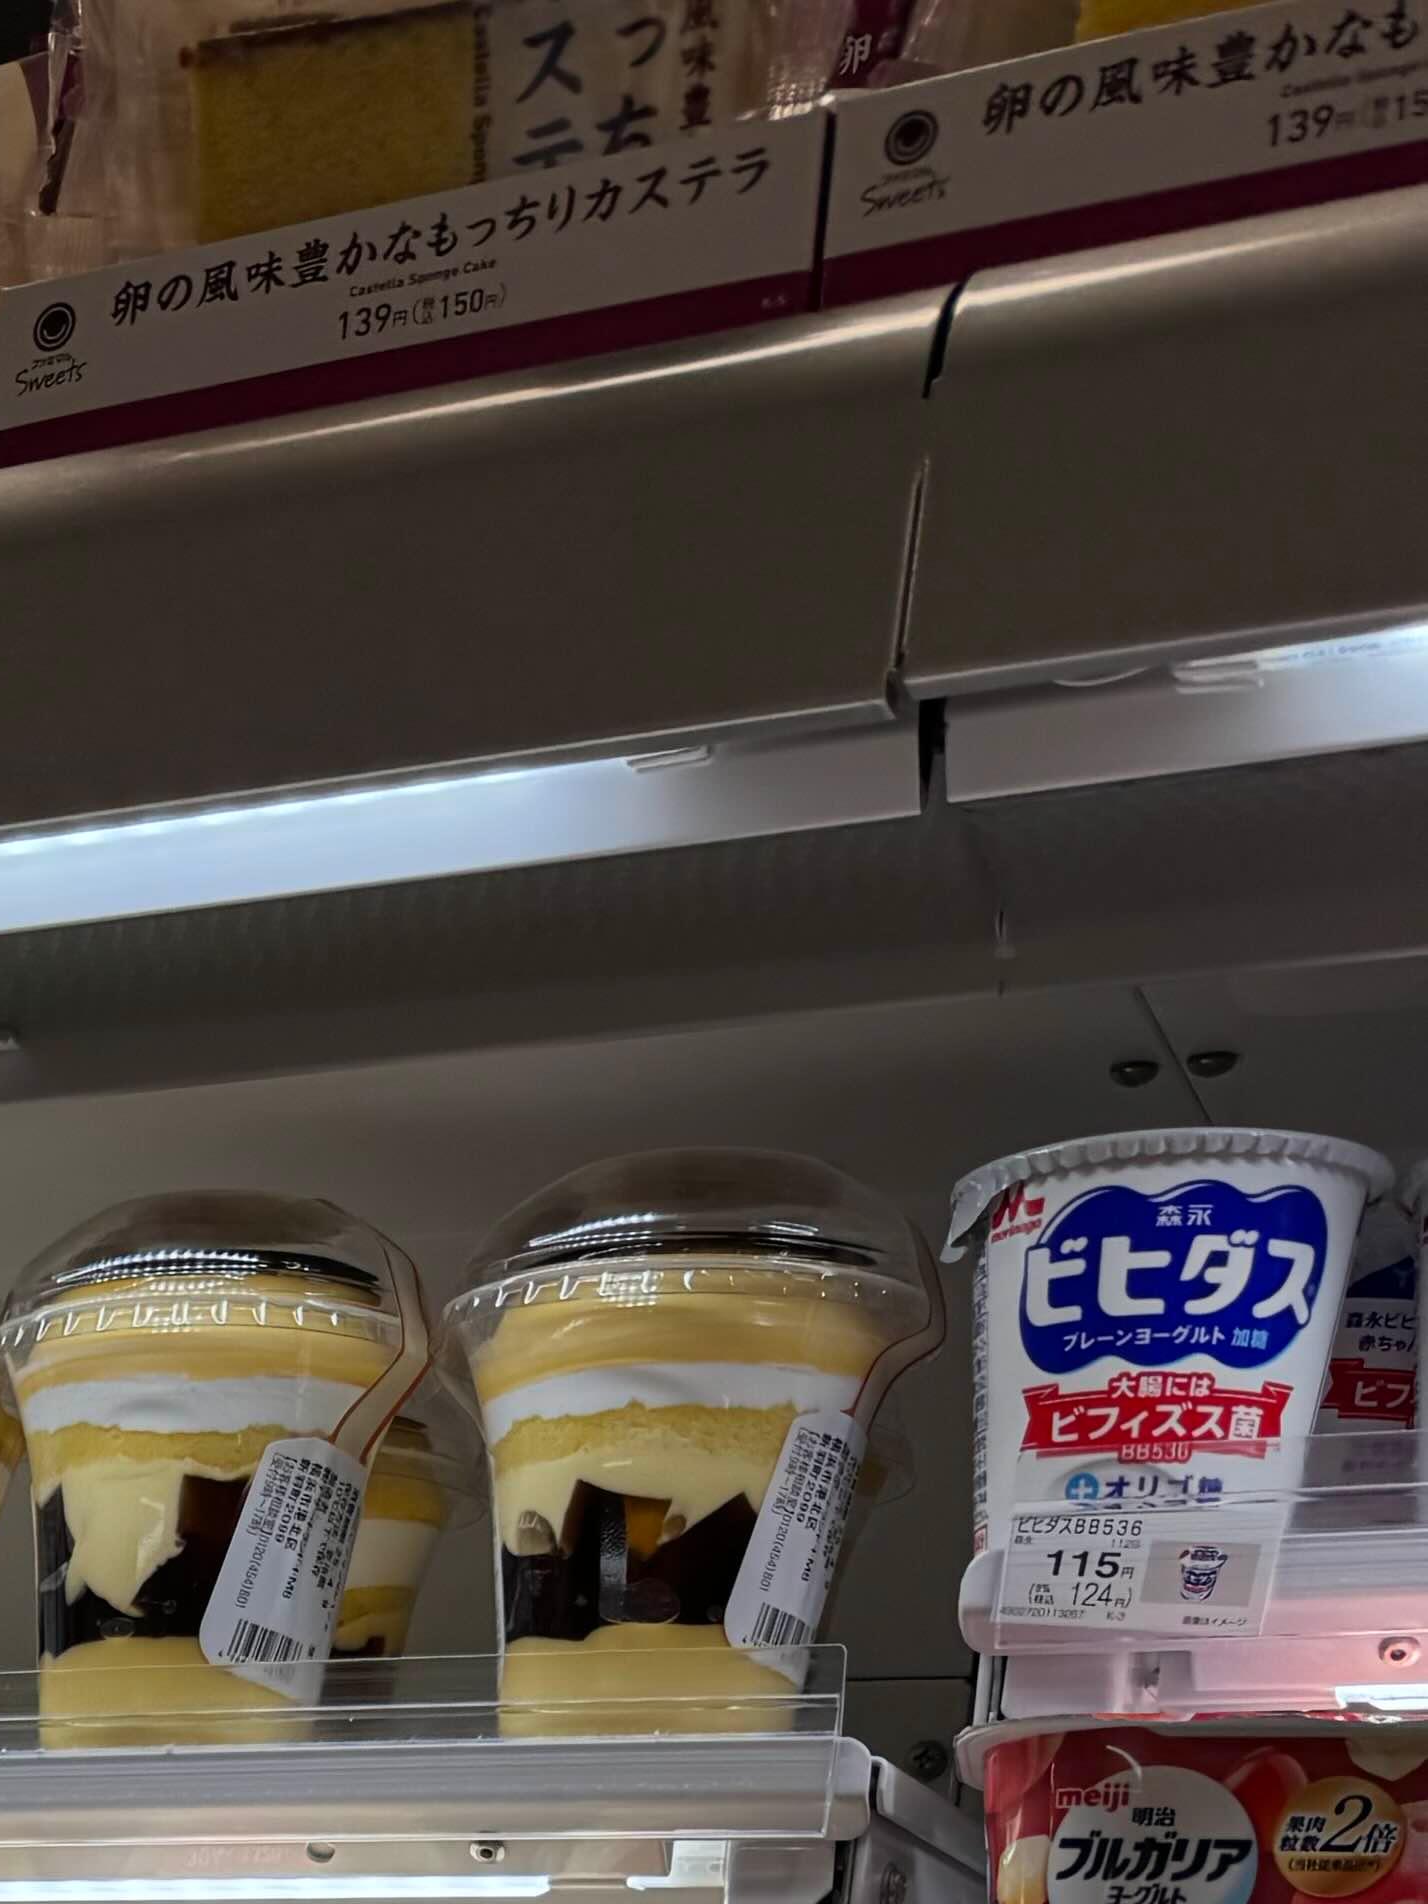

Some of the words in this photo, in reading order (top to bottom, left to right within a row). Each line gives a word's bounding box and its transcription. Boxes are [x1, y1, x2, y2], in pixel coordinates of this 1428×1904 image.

[838, 32, 873, 76] 卵
[859, 176, 950, 217] Sweets
[110, 145, 773, 330] 卵の風味豊かなもっちりカステラ
[467, 257, 498, 275] Cake
[16, 360, 88, 397] Sweets
[1154, 1203, 1214, 1228] 森永
[1026, 1232, 1318, 1328] ビヒダス
[1062, 1326, 1226, 1354] プレーンヨーグルト
[1232, 1326, 1268, 1350] 加糖
[1110, 1372, 1211, 1400] 大腸には
[1049, 1402, 1265, 1445] ビフィズス菌
[1056, 1783, 1131, 1812] meiji
[1132, 1807, 1176, 1827] 明治
[1285, 1816, 1327, 1833] 果肉
[1055, 1830, 1254, 1883] ブルガリア
[1279, 1835, 1320, 1853] 粒数
